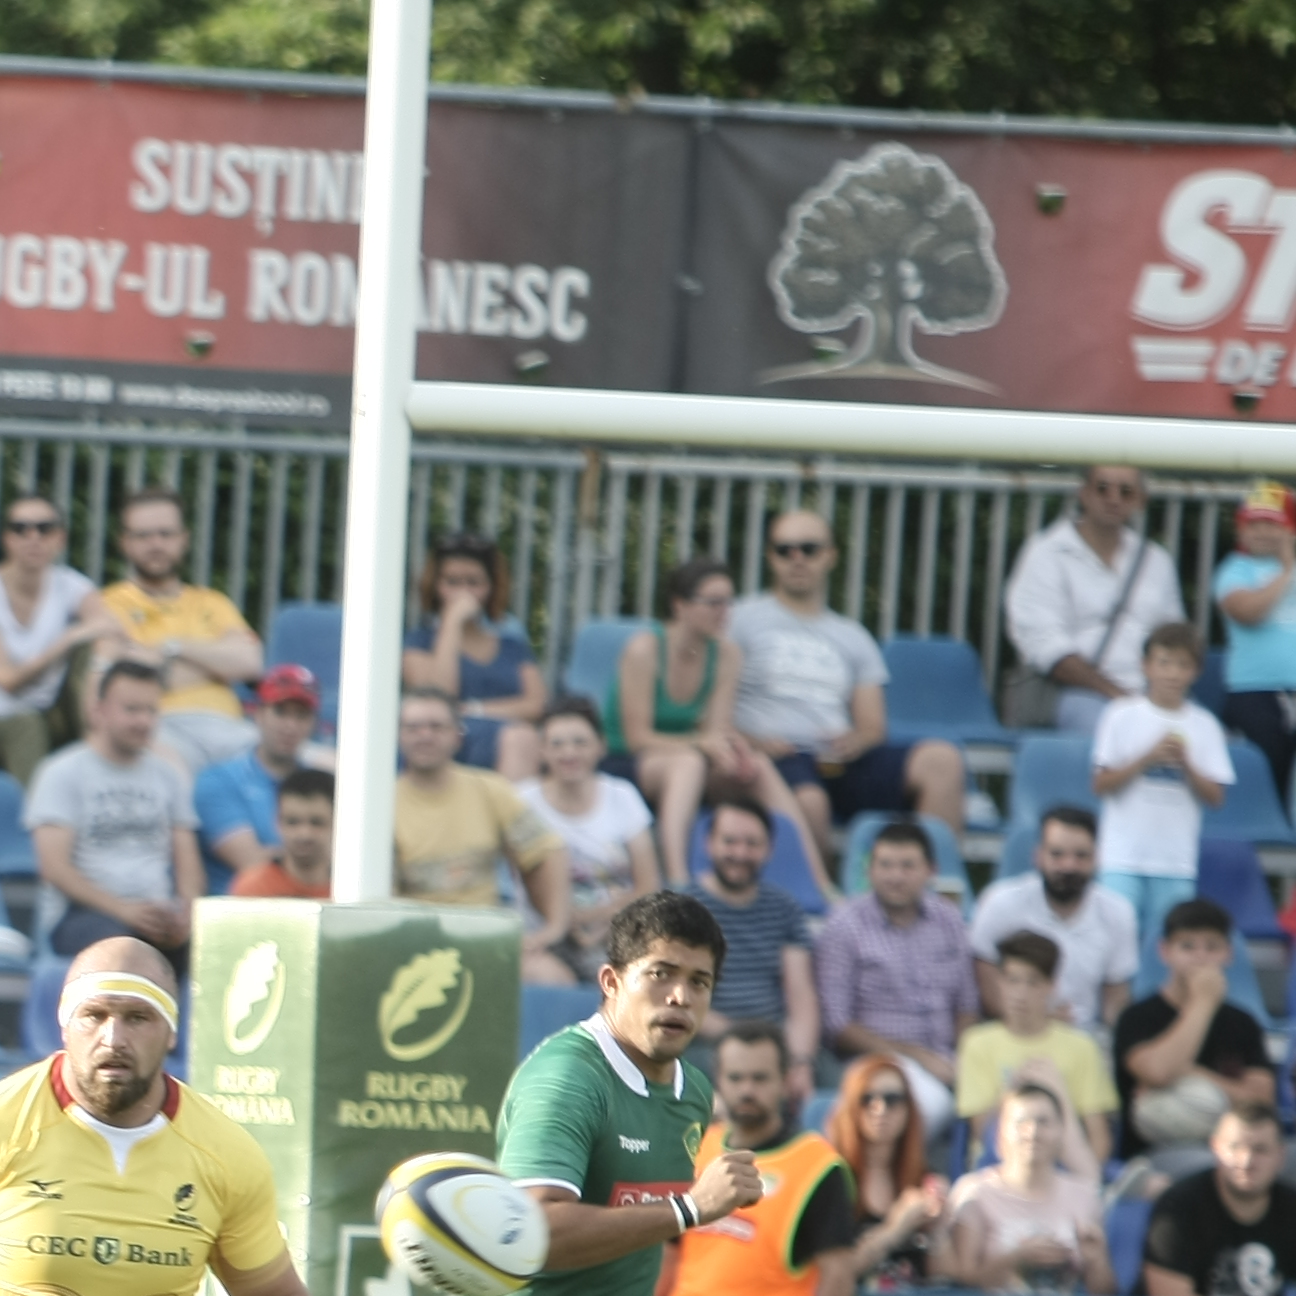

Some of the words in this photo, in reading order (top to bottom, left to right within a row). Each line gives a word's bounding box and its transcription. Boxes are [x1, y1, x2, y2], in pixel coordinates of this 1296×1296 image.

[1214, 338, 1288, 388] DE
[365, 1070, 469, 1102] RUGBY
[27, 1235, 87, 1258] CEC
[126, 1242, 194, 1267] Bank
